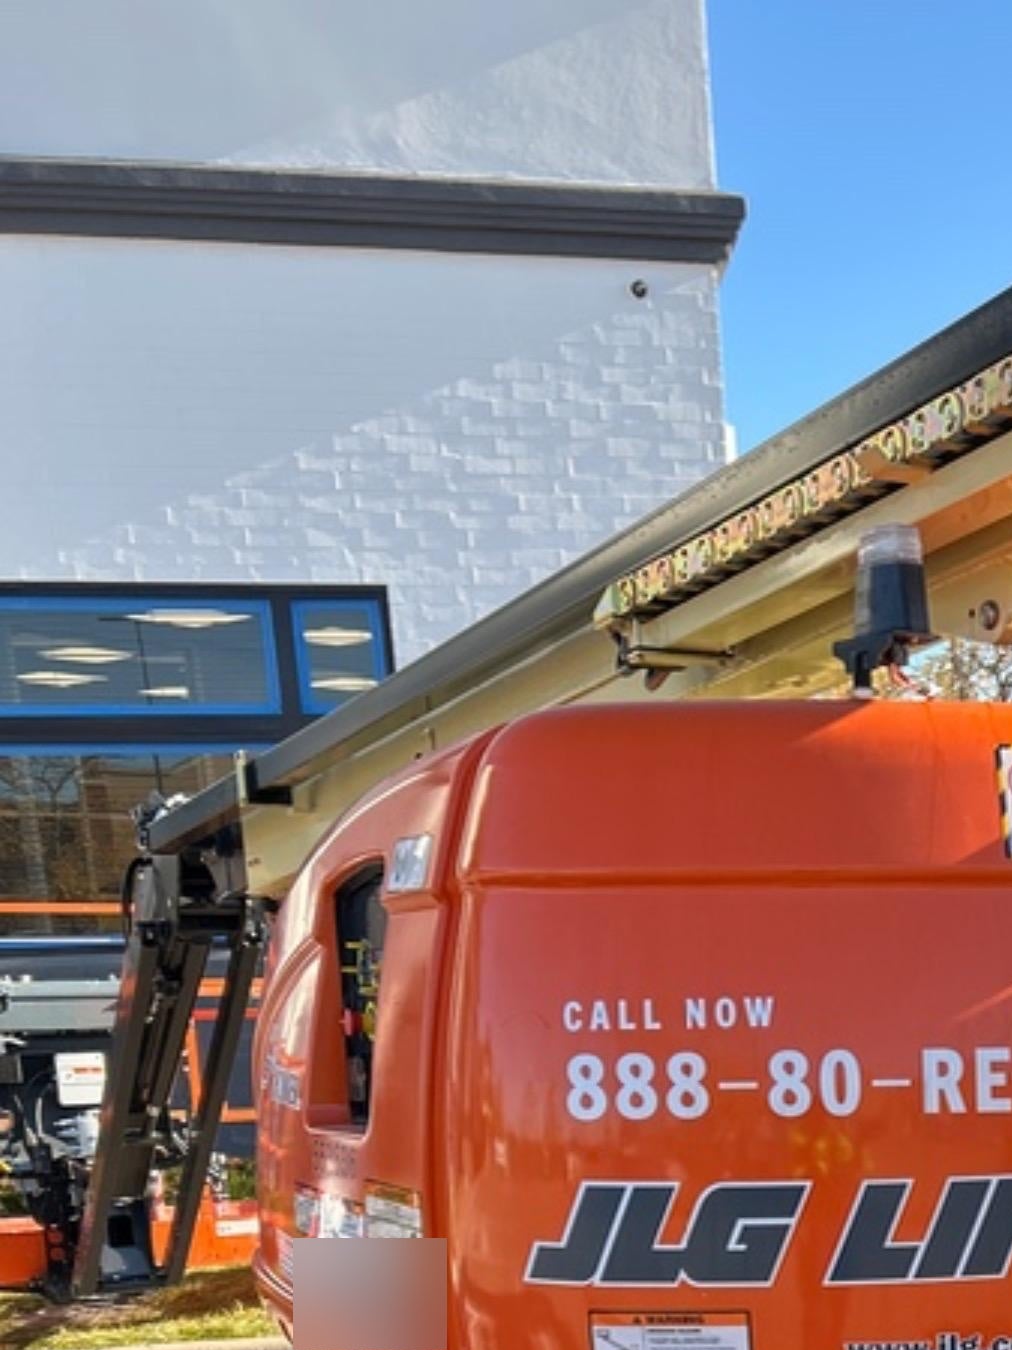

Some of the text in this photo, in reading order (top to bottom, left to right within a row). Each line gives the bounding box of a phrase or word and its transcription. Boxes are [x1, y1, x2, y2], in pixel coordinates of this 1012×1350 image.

[563, 996, 774, 1032] CALL NOW
[523, 1180, 813, 1288] JLG
